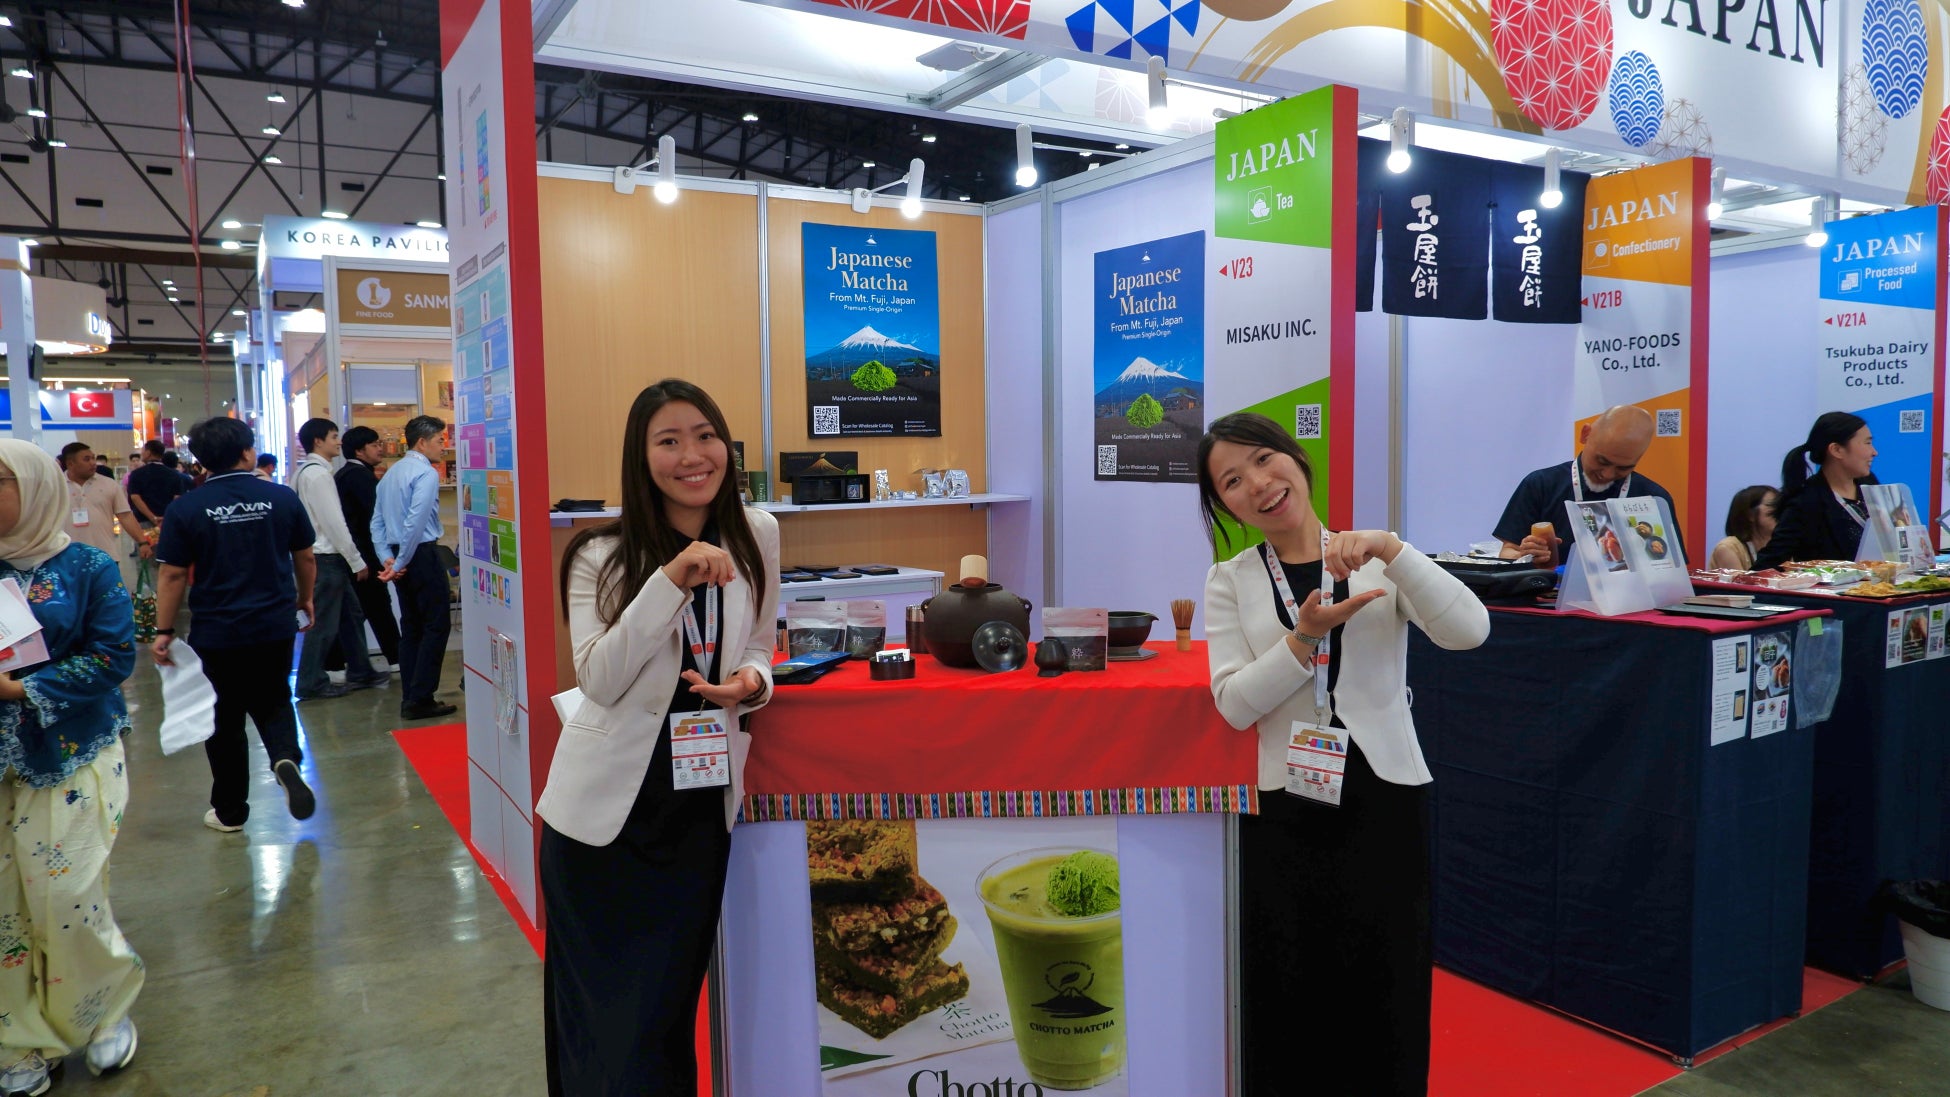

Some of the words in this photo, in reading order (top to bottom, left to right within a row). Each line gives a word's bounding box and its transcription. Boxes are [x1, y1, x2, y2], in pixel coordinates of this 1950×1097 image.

[1628, 0, 1829, 68] PAN
[1227, 128, 1318, 182] JAPAN
[1276, 192, 1293, 210] Tea
[1587, 191, 1678, 231] JAPAN
[288, 230, 360, 246] KOREA
[1612, 236, 1680, 257] Confectionery
[1832, 232, 1924, 263] JAPAN
[827, 246, 912, 271] Japanese
[1232, 256, 1252, 280] V23
[1864, 262, 1917, 280] Processed
[841, 270, 908, 292] Matcha
[1109, 267, 1182, 299] Japanese
[1878, 278, 1902, 291] Food
[404, 294, 450, 309] SANM
[830, 292, 852, 302] From
[854, 294, 868, 303] Mt.
[871, 294, 888, 306] Fuji,
[890, 296, 916, 306] Japan
[1120, 291, 1176, 316] Matcha
[1592, 290, 1622, 309] V21B
[868, 306, 902, 314] Single-Origin
[1110, 322, 1129, 332] From
[1131, 320, 1142, 330] Mt.
[1144, 318, 1159, 330] Fuji,
[1160, 316, 1183, 328] Japan
[1836, 312, 1866, 328] V21A
[1226, 322, 1280, 344] MISAKU
[1286, 318, 1316, 338] INC.
[1584, 332, 1680, 354] YANO-FOODS
[1825, 344, 1884, 358] Tsukuba
[1888, 340, 1928, 355] Dairy
[1602, 357, 1629, 372] Co.,
[1633, 353, 1660, 369] Ltd.
[1843, 358, 1908, 372] Products
[1845, 376, 1872, 388] Co.,
[1876, 372, 1904, 386] Ltd.
[940, 1013, 1000, 1032] Chotto
[946, 1022, 1009, 1040] Matcha
[1030, 1022, 1070, 1035] CHOTTO
[1074, 1020, 1115, 1034] MATCHA
[908, 1070, 1044, 1097] Chotto
